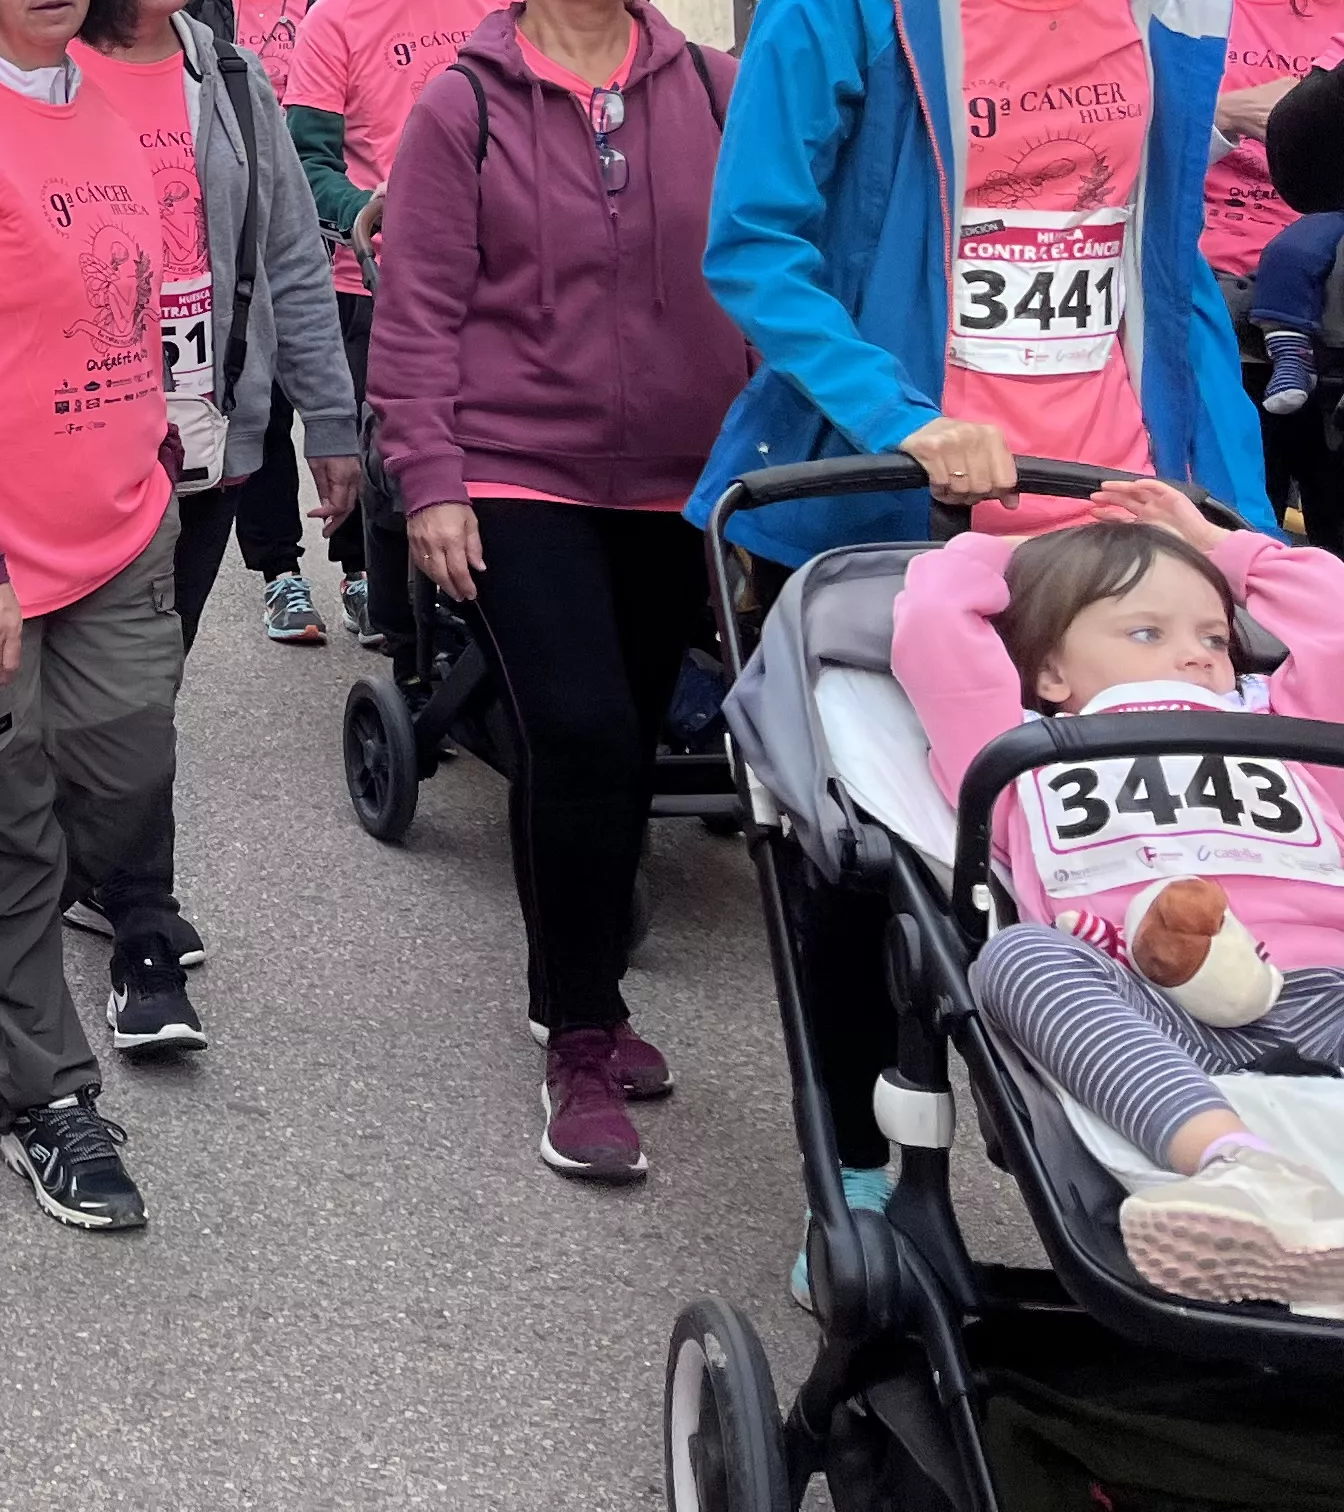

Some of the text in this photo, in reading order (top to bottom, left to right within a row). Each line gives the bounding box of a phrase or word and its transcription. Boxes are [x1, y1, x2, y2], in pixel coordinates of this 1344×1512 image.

[1019, 81, 1127, 113] CÁNCER
[75, 181, 133, 204] CÁNCER
[178, 289, 211, 305] HUESCA
[191, 302, 204, 315] EL
[959, 266, 1115, 331] 3441
[1047, 754, 1304, 841] 3443
